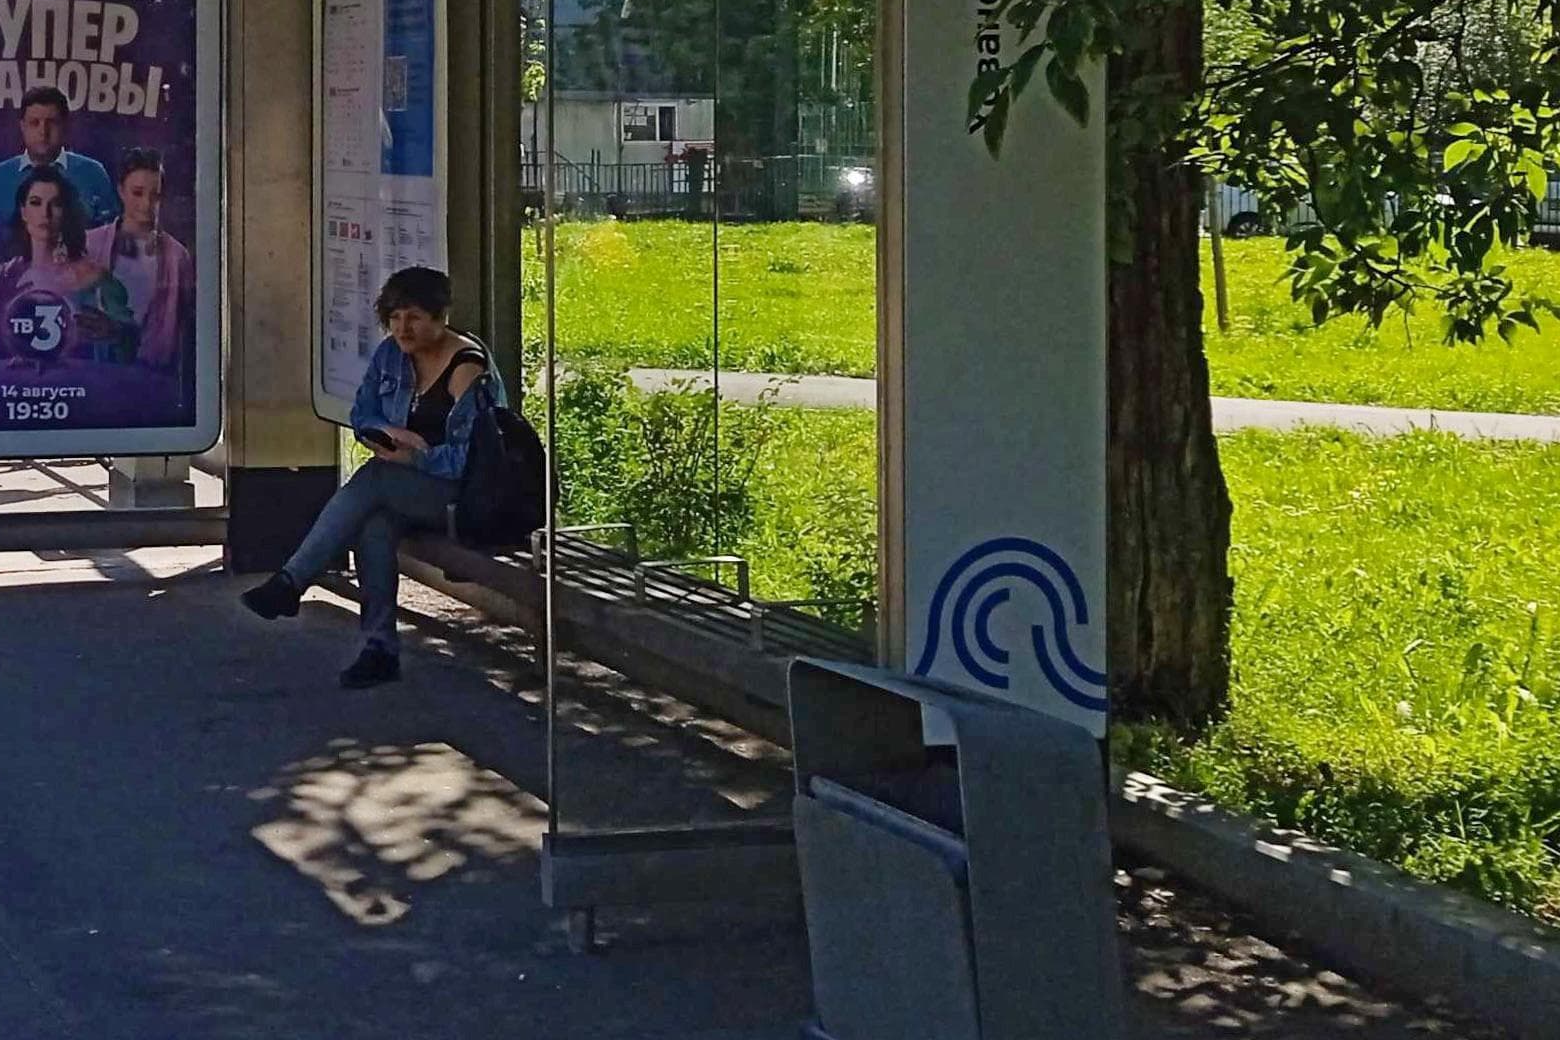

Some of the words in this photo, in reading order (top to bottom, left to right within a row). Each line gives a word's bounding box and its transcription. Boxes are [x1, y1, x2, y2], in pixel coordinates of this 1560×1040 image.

[1, 385, 18, 397] 14
[22, 386, 86, 400] августа
[6, 402, 69, 420] 19:30
